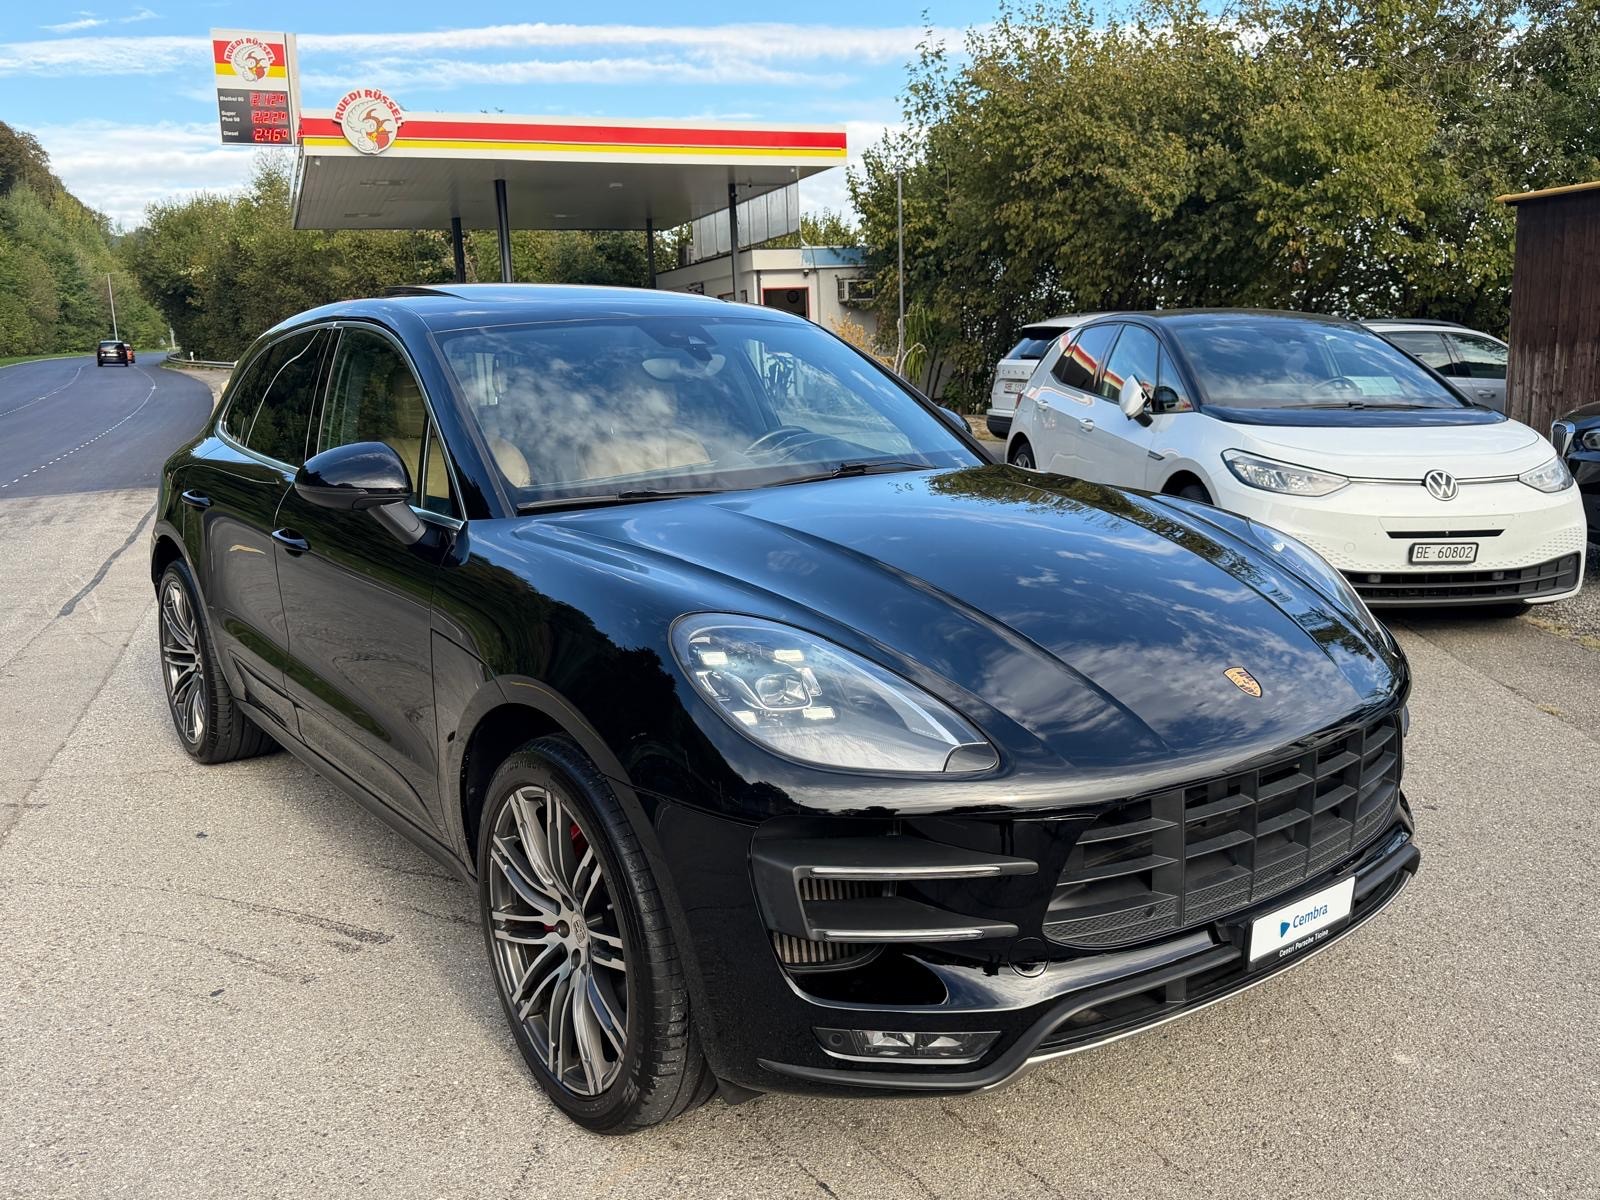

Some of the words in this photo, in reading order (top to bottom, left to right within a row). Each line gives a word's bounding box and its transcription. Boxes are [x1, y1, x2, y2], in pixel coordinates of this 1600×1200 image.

[226, 38, 244, 60] RUEDI
[245, 37, 274, 62] RÜSSEL
[335, 90, 362, 120] RUEDI
[364, 89, 402, 124] RÜSSEL
[1416, 546, 1431, 559] BE
[1437, 546, 1473, 559] 60802
[1292, 904, 1328, 929] Cembra
[1295, 936, 1314, 950] Porsche
